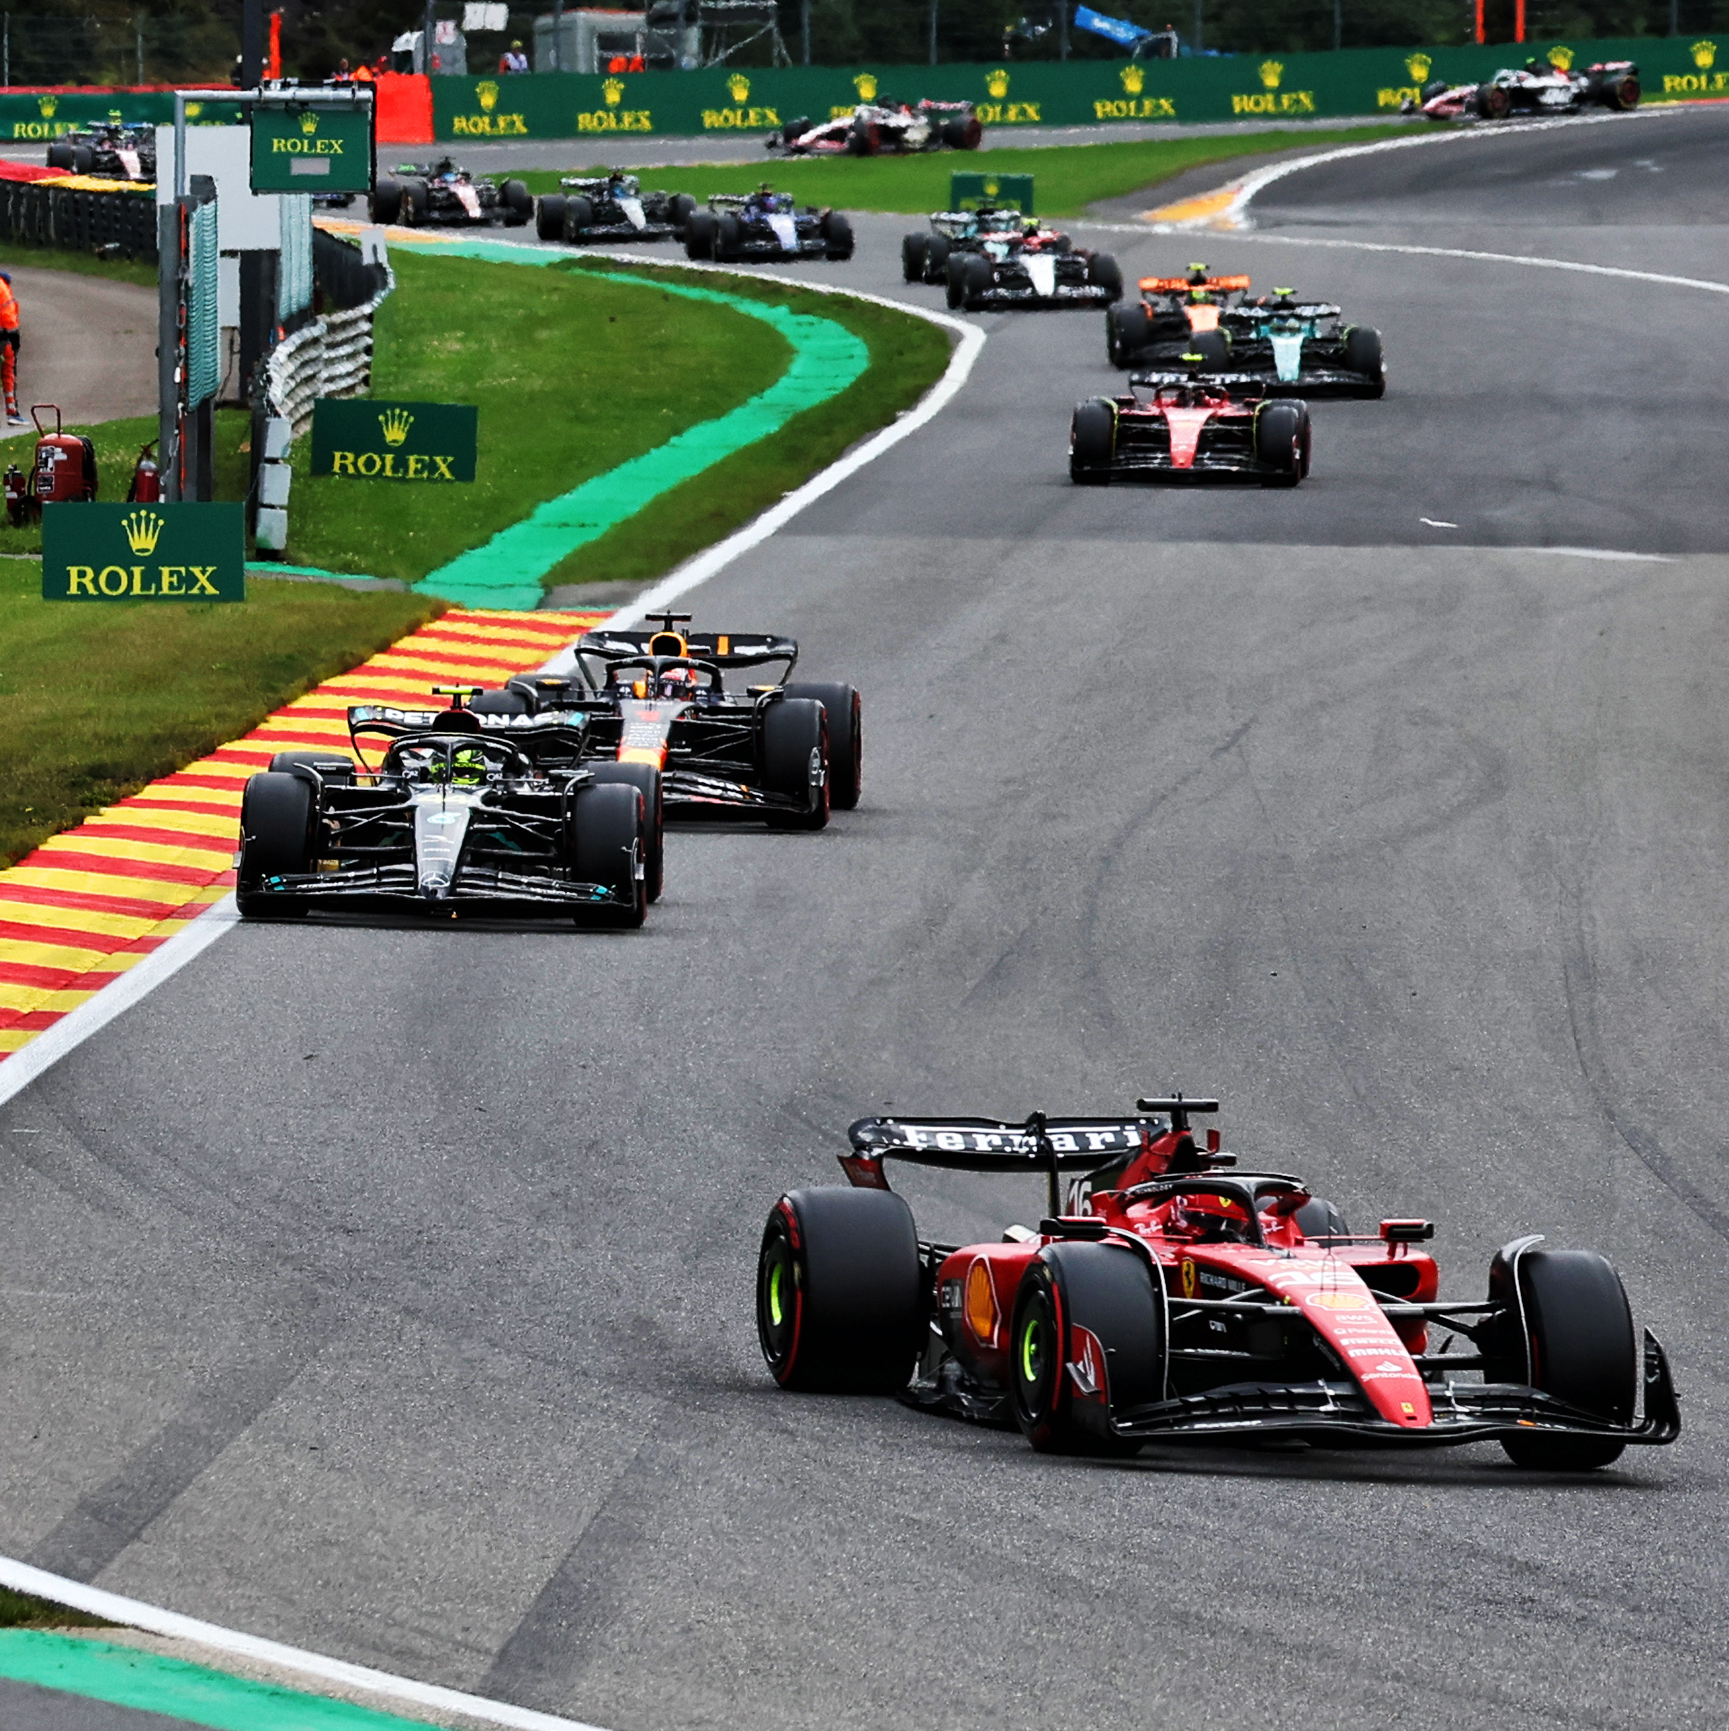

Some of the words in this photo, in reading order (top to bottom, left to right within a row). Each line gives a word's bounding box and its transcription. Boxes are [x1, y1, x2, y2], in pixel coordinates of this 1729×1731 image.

[1095, 99, 1174, 118] ROLEX
[1233, 92, 1313, 112] ROLEX
[454, 115, 527, 134] ROLEX
[578, 111, 651, 131] ROLEX
[702, 108, 780, 127] ROLEX
[272, 138, 343, 154] ROLEX
[332, 451, 454, 479] ROLEX
[69, 566, 218, 595] ROLEX
[1069, 1180, 1092, 1217] 16
[1268, 1271, 1367, 1288] 16
